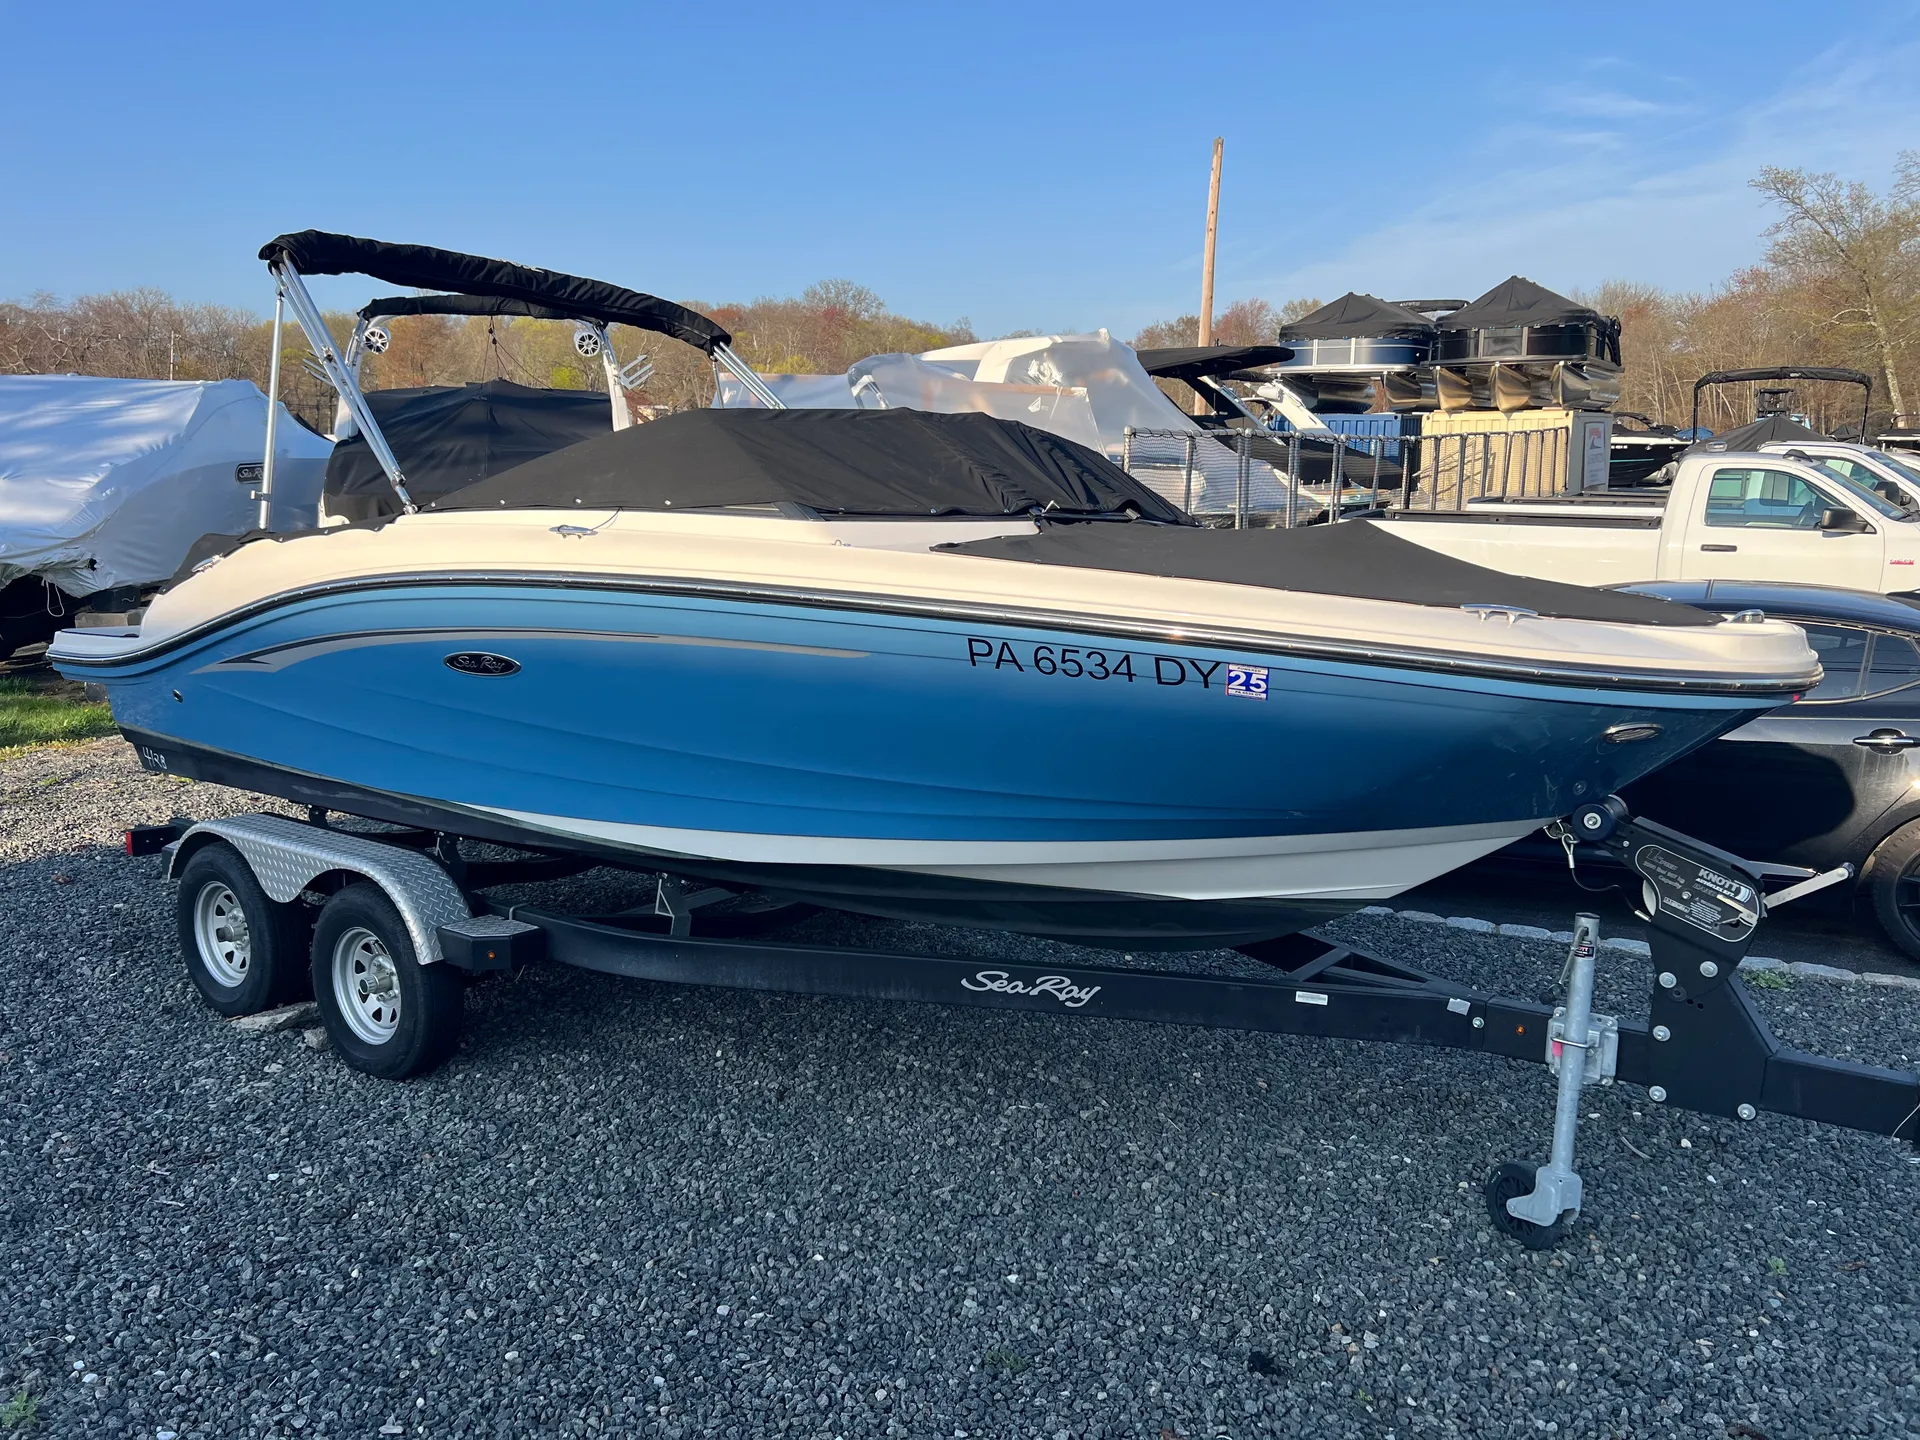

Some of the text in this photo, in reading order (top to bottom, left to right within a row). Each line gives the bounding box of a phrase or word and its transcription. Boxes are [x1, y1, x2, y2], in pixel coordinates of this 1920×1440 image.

[454, 656, 505, 673] Sea Ray
[967, 638, 1221, 689] PA 6534 DY
[1228, 670, 1267, 693] 25
[1698, 867, 1740, 892] KNOTT
[961, 971, 1101, 1008] Sea Ray
